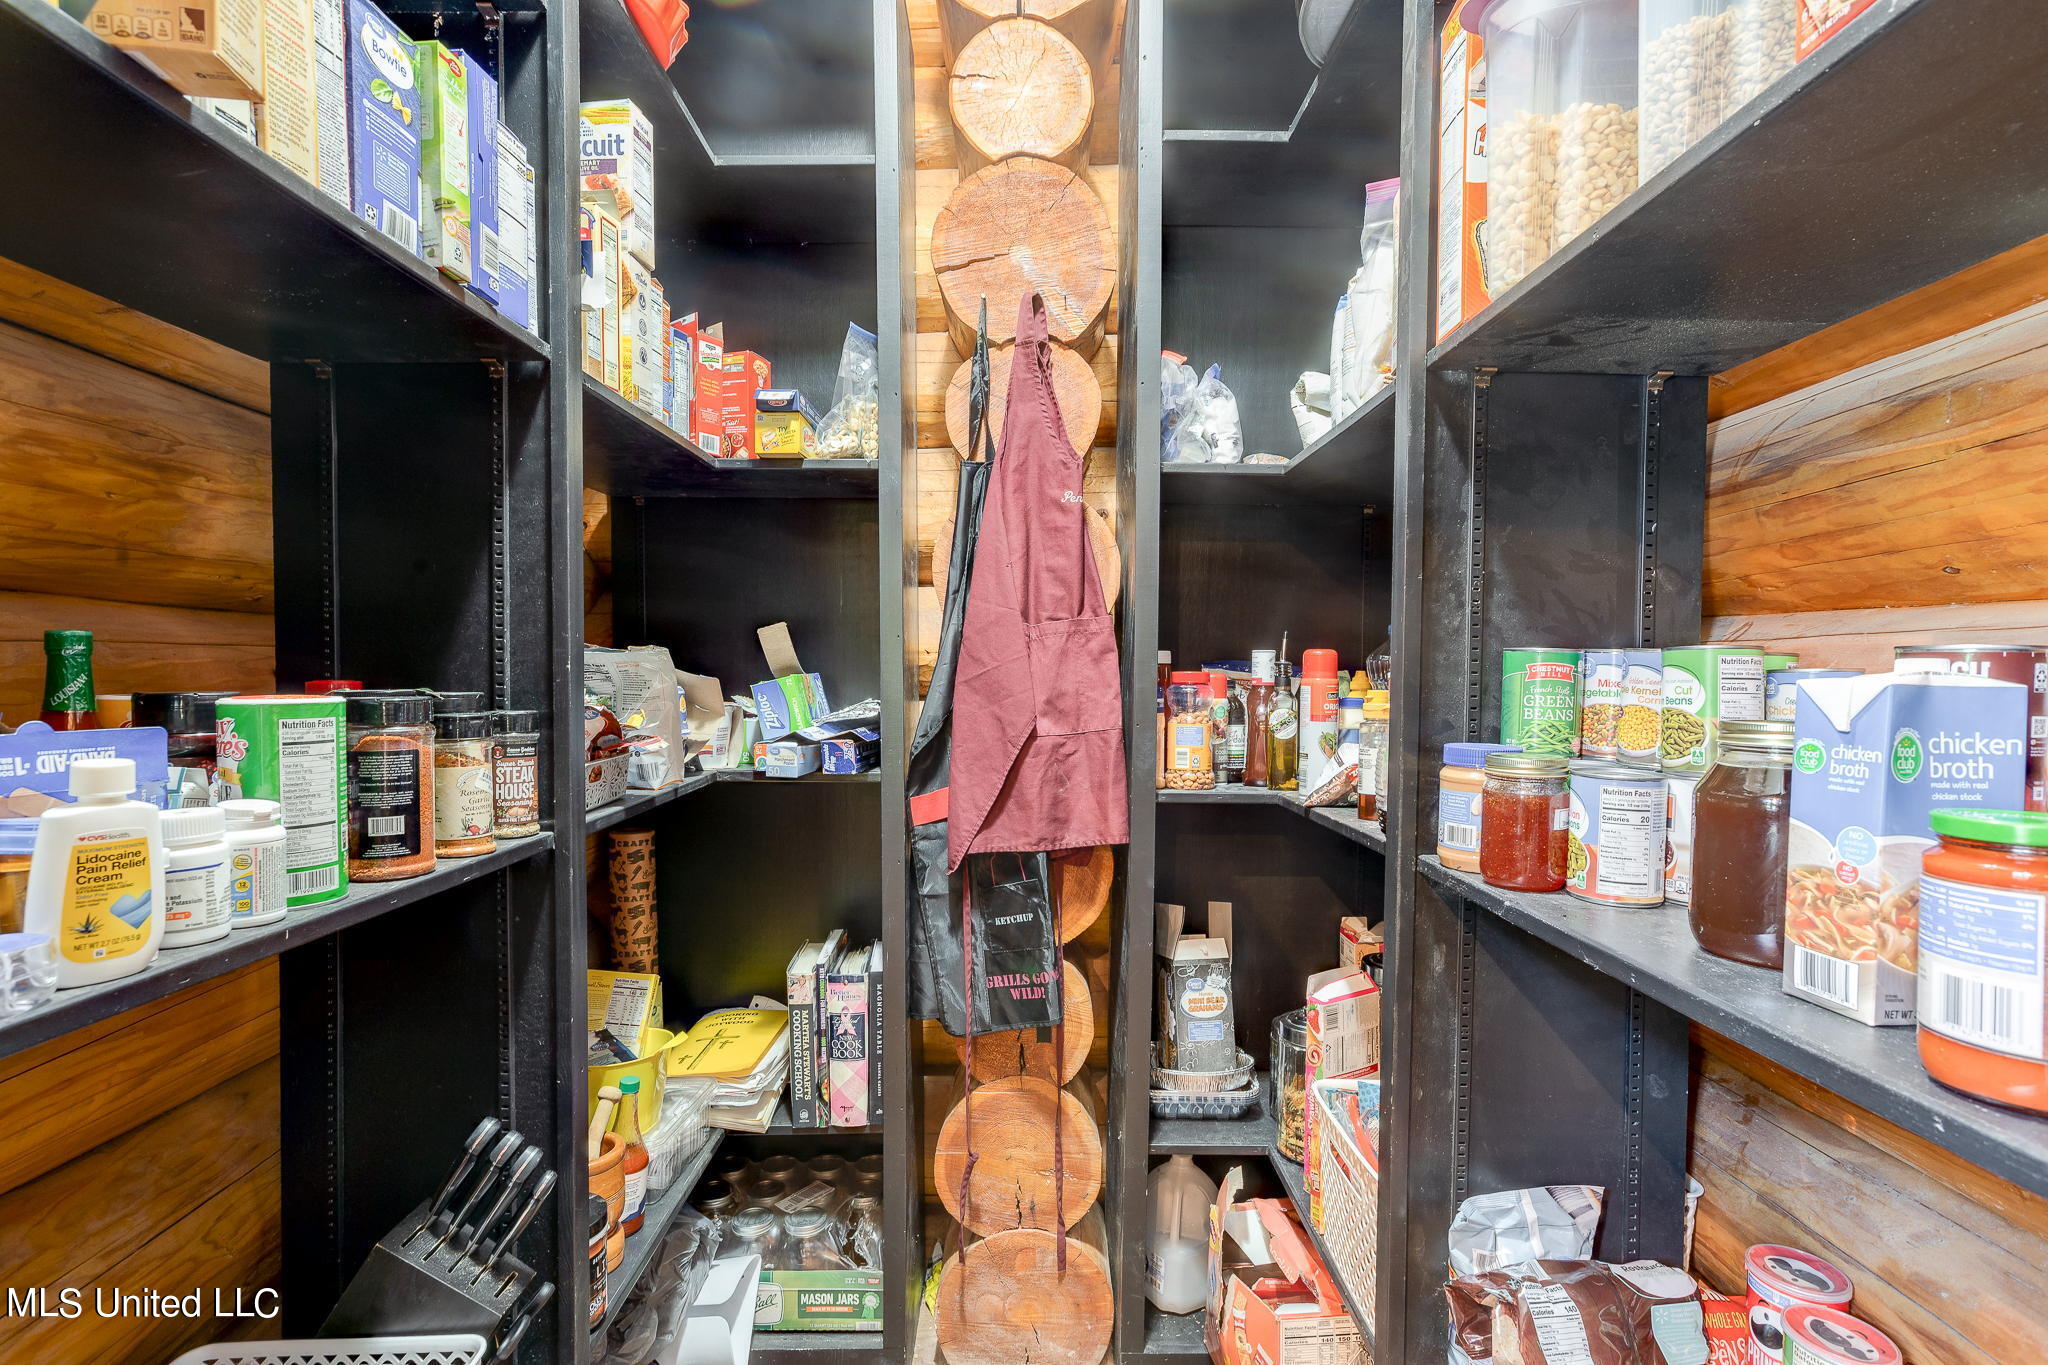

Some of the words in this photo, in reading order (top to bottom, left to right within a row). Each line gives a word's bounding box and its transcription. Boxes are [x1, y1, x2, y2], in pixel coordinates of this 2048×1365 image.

[372, 39, 407, 78] Bowtie
[580, 133, 625, 157] cuit
[1531, 665, 1571, 674] CHESTNUT
[1598, 679, 1622, 688] Mixe
[50, 673, 88, 706] LOUISIANA
[1674, 685, 1693, 695] Cut
[1523, 695, 1575, 708] GREEN
[1637, 696, 1661, 704] Corn
[1665, 696, 1693, 705] Beans
[757, 692, 782, 731] Ziploc
[1523, 707, 1574, 721] BEANS
[281, 719, 316, 730] Nutrition
[317, 719, 334, 728] Facts
[1928, 731, 2023, 756] chicken
[282, 749, 309, 757] Calories
[1799, 748, 1821, 758] food
[1830, 743, 1883, 763] chicken
[1897, 745, 1916, 757] food
[1799, 756, 1819, 766] club
[1896, 758, 1915, 769] club
[1829, 761, 1870, 779] broth
[1929, 756, 1995, 779] broth
[495, 766, 535, 783] STEAK
[1930, 781, 1950, 789] made
[1952, 780, 1971, 789] with
[1973, 780, 1989, 789] real
[495, 782, 535, 800] HOUSE
[1602, 788, 1633, 797] Nutrition
[1634, 790, 1652, 798] Facts
[1932, 792, 1959, 801] chicken
[1959, 793, 1983, 801] stock
[496, 798, 533, 808] Seasoning
[1601, 815, 1630, 823] Calories
[1640, 816, 1650, 824] 20
[1848, 831, 1864, 840] NO
[616, 839, 650, 848] CRAFT
[76, 850, 142, 865] Lidocaine
[76, 864, 107, 875] Pain
[112, 857, 147, 871] Relief
[76, 872, 123, 885] Cream
[618, 894, 651, 903] CRAFT
[994, 913, 1034, 926] KETCHUP
[73, 943, 88, 952] NET
[89, 941, 99, 949] WT
[618, 950, 651, 959] CRAFT
[986, 973, 1030, 989] GRILLS
[1009, 986, 1046, 1000] WILD!
[714, 1012, 760, 1020] COOKING
[1884, 1010, 1899, 1019] NET
[1901, 1010, 1914, 1019] WT
[801, 1010, 811, 1049] MARTHA
[792, 1010, 804, 1061] COOKING
[831, 1039, 863, 1050] COOK
[832, 1049, 863, 1059] BOOK
[802, 1050, 812, 1101] STEWART'S
[793, 1062, 804, 1101] SCHOOL
[1545, 1285, 1563, 1294] Facts
[800, 1293, 835, 1306] MASON
[835, 1292, 860, 1306] JARS
[1564, 1305, 1578, 1314] 140
[1704, 1312, 1731, 1329] WHOLE
